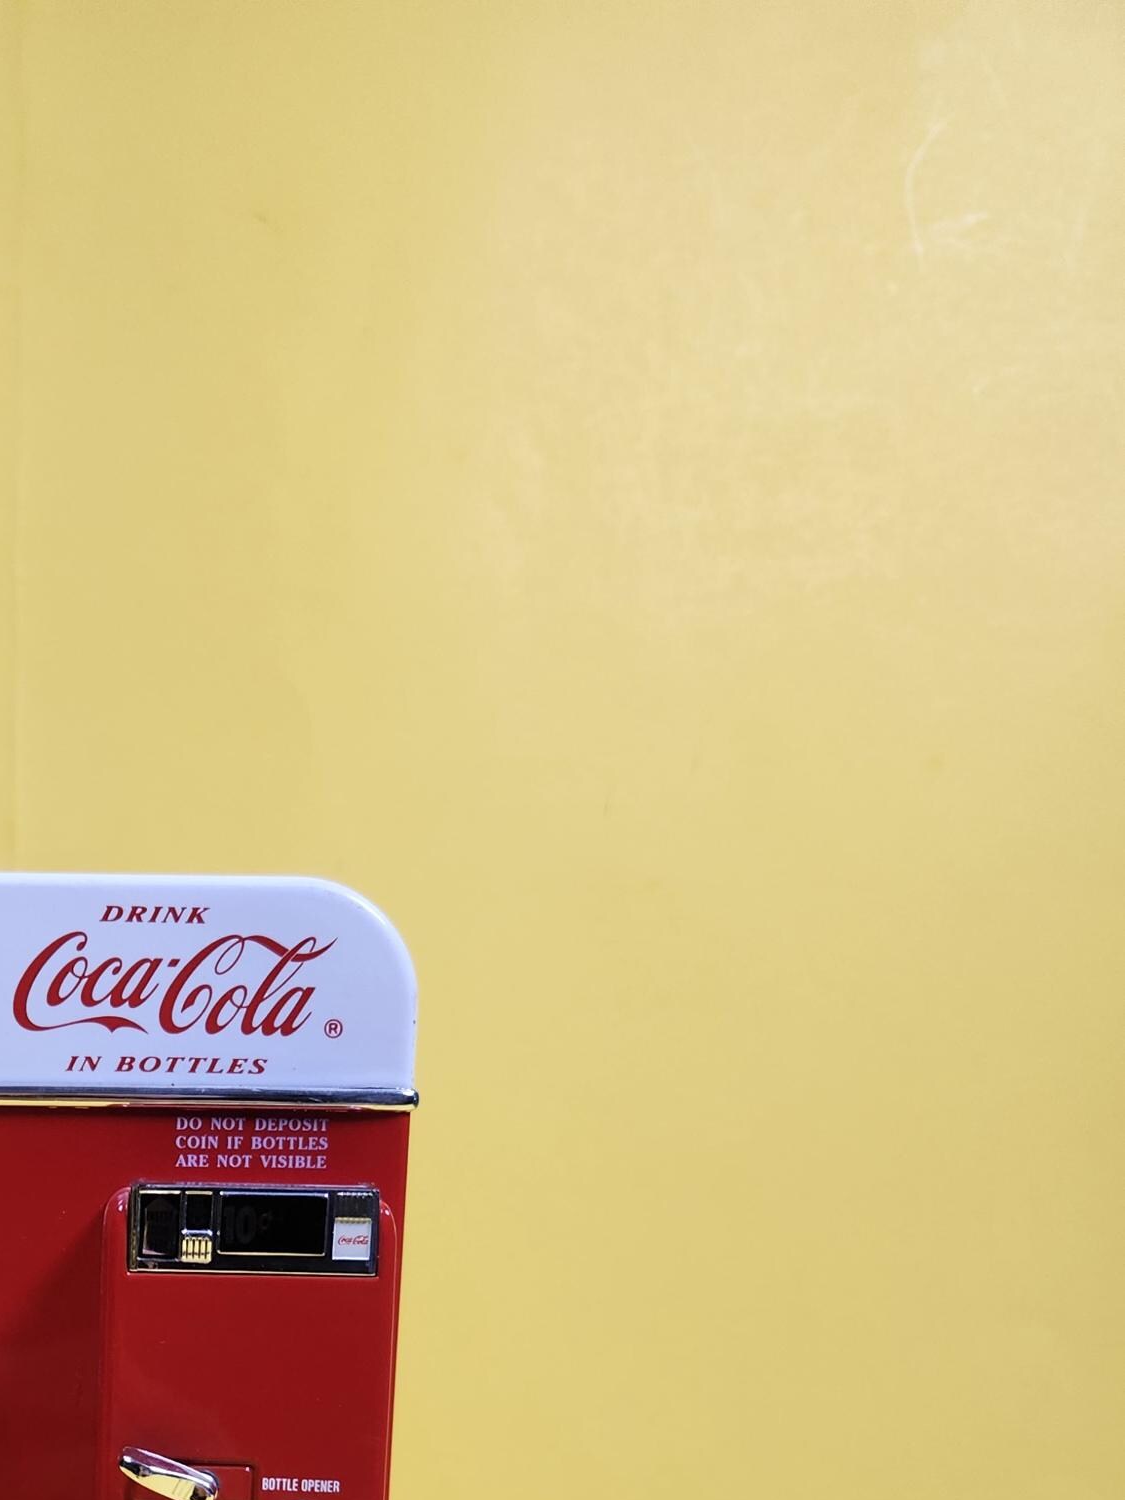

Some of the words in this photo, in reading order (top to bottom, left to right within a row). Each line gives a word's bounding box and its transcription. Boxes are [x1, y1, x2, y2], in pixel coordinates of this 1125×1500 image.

[99, 906, 211, 924] DRINK
[13, 931, 338, 1037] Coca-Cola
[65, 1055, 103, 1072] IN
[115, 1056, 268, 1075] BOTTLES
[176, 1117, 202, 1131] DO
[210, 1118, 246, 1131] NOT
[254, 1118, 329, 1132] DEPOSIT
[175, 1135, 219, 1149] COIN
[226, 1136, 243, 1149] IF
[251, 1137, 328, 1150] BOTTLES
[175, 1154, 209, 1168] ARE
[216, 1155, 252, 1168] NOT
[260, 1155, 327, 1169] VISIBLE
[262, 1478, 298, 1492] BOTTLE
[301, 1479, 340, 1493] OPENER
